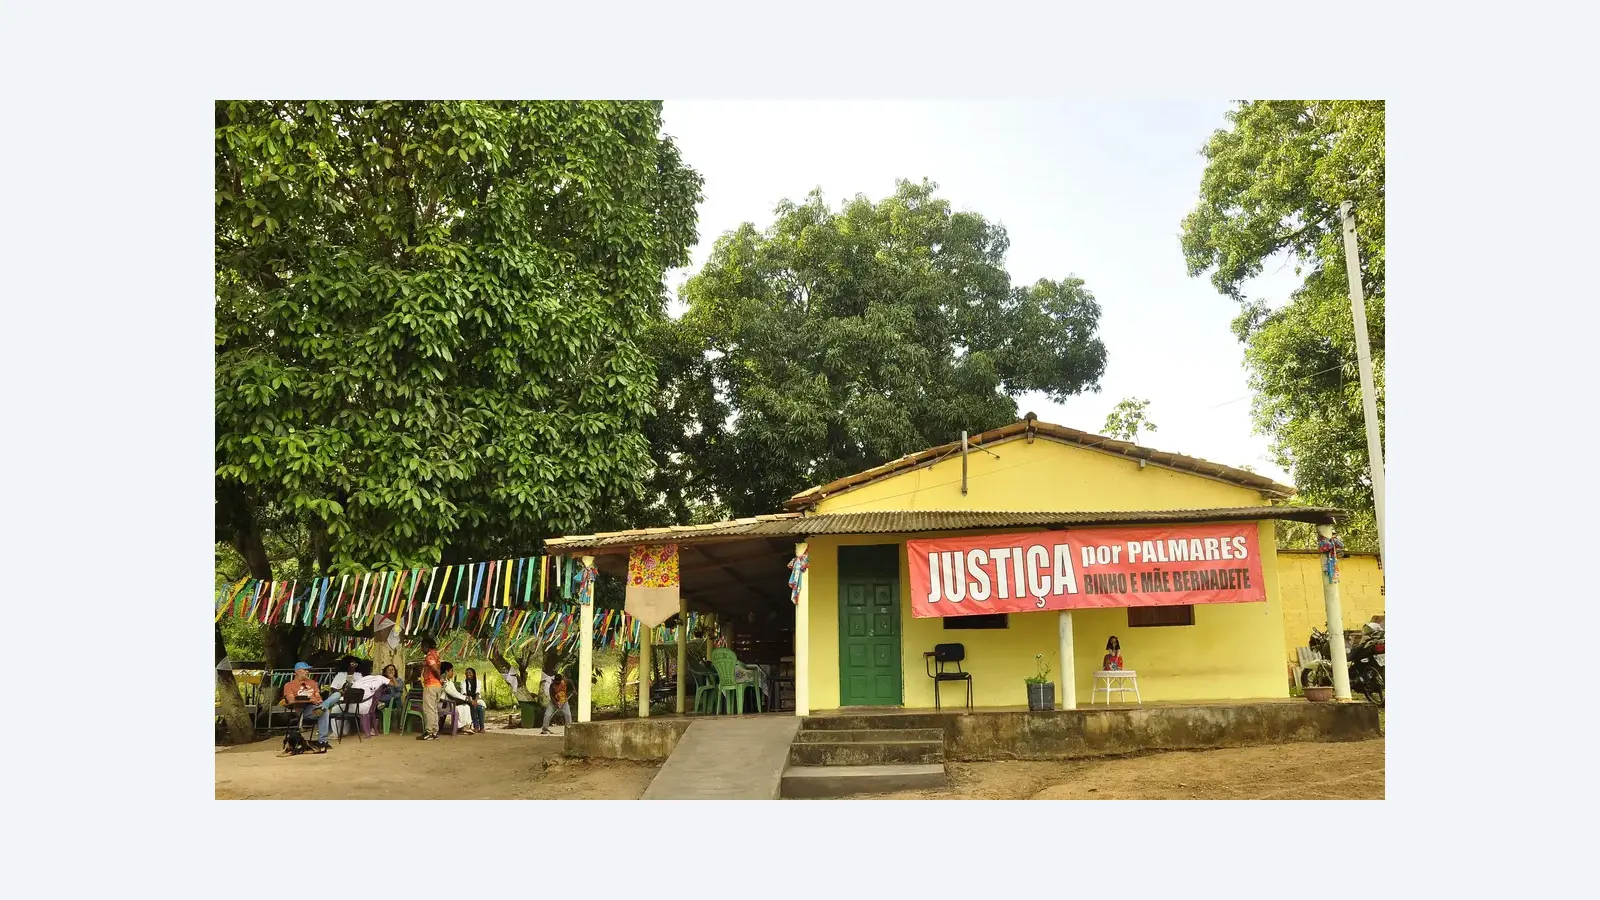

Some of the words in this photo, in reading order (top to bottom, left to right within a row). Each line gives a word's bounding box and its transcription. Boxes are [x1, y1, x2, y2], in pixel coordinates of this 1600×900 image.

[1080, 545, 1122, 568] por
[1126, 536, 1248, 564] PALMARES
[928, 543, 1079, 608] JUSTIÇA
[1083, 572, 1128, 595] BINHO
[1130, 572, 1139, 593] E
[1140, 568, 1171, 593] MÃE
[1172, 568, 1251, 592] BERNADETE
